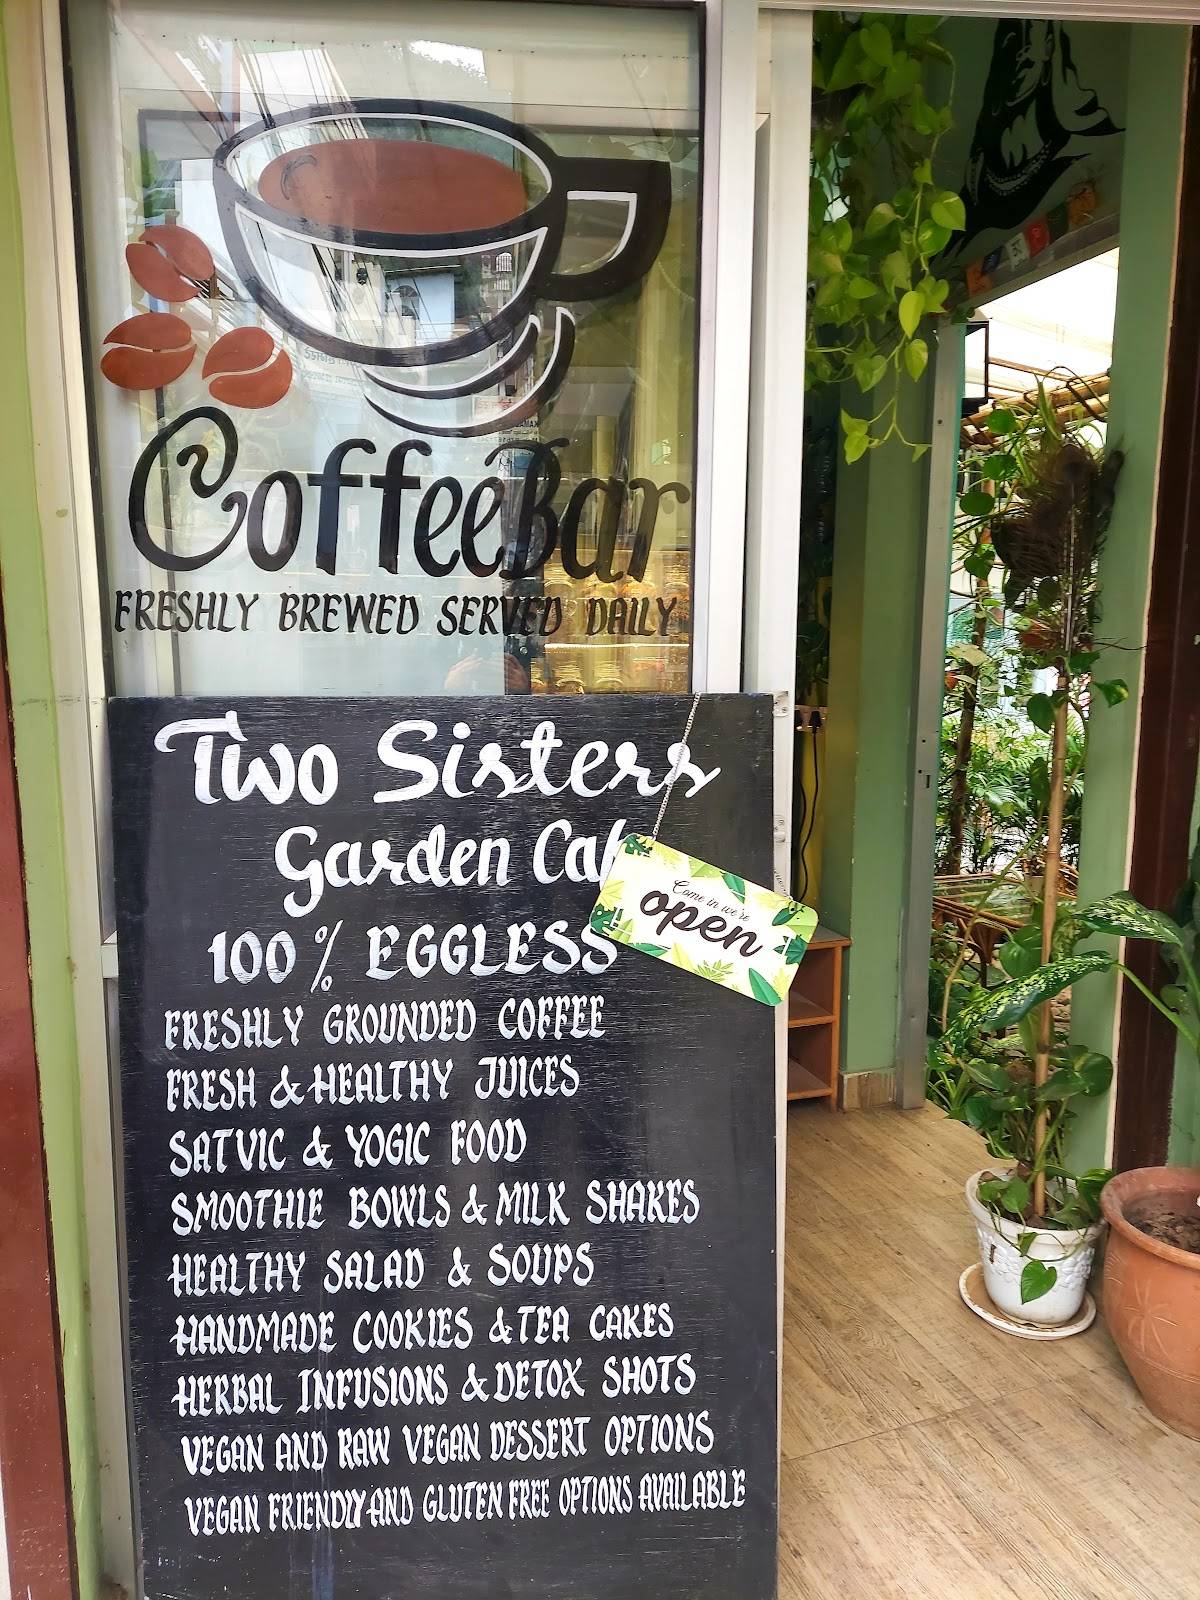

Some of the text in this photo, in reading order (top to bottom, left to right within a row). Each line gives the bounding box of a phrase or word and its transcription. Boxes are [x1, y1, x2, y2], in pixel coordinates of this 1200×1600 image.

[114, 589, 677, 636] FRESHLY BREWED SERVED DAILY
[154, 710, 721, 805] Two Sisters
[275, 819, 626, 916] Garden Caf
[672, 879, 705, 902] Come
[706, 897, 720, 910] in
[366, 921, 618, 977] EGGLESS
[640, 891, 763, 956] open
[165, 995, 605, 1051] FRESHLY GROUNDED COFFEE
[167, 1054, 579, 1112] FRESH & HEALTHY JUICES
[170, 1118, 526, 1177] SATVIC & YOGIC FOOD
[172, 1179, 699, 1236] SMOOTHIE BOWLS & MILK SHAKES
[167, 1242, 594, 1297] HEALTHY SALAD & SOUPS
[169, 1302, 673, 1356] HANDMADE COOKIES & TEA CAKES
[171, 1353, 696, 1417] HERBAL INFUSIONS & DETOX SHOTS
[181, 1410, 714, 1476] VEGAN AND RAW VEGAN DESSERT OPTIONS
[184, 1469, 745, 1536] VEGAN FRIENDLY AND GLUTEN FREE OPTIONS AVAILABLE
